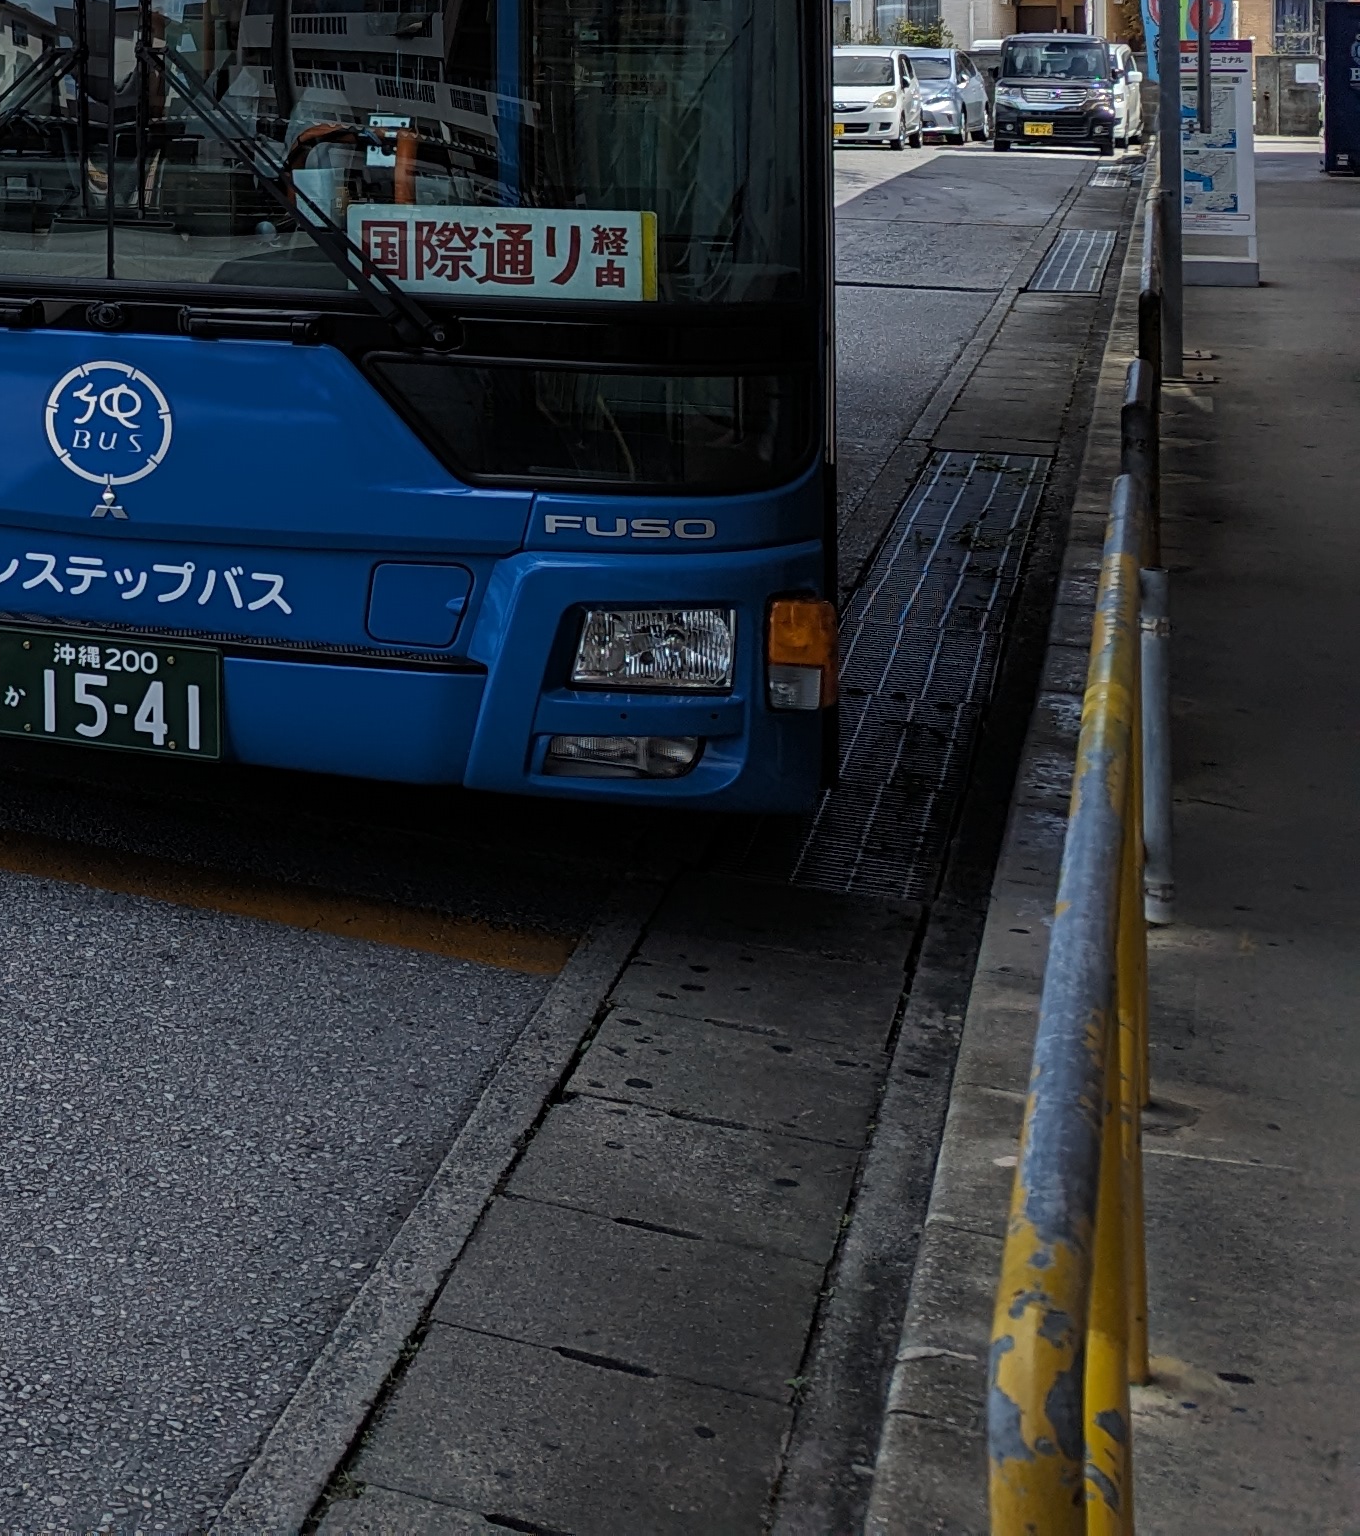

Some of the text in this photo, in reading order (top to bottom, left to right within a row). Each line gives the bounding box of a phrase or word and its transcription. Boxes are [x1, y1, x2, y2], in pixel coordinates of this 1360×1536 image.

[359, 218, 630, 289] 国際通り 経由
[71, 428, 144, 454] BUS
[543, 513, 717, 541] FUSO
[52, 640, 159, 675] 沖縄200
[3, 667, 201, 752] か 15-41
